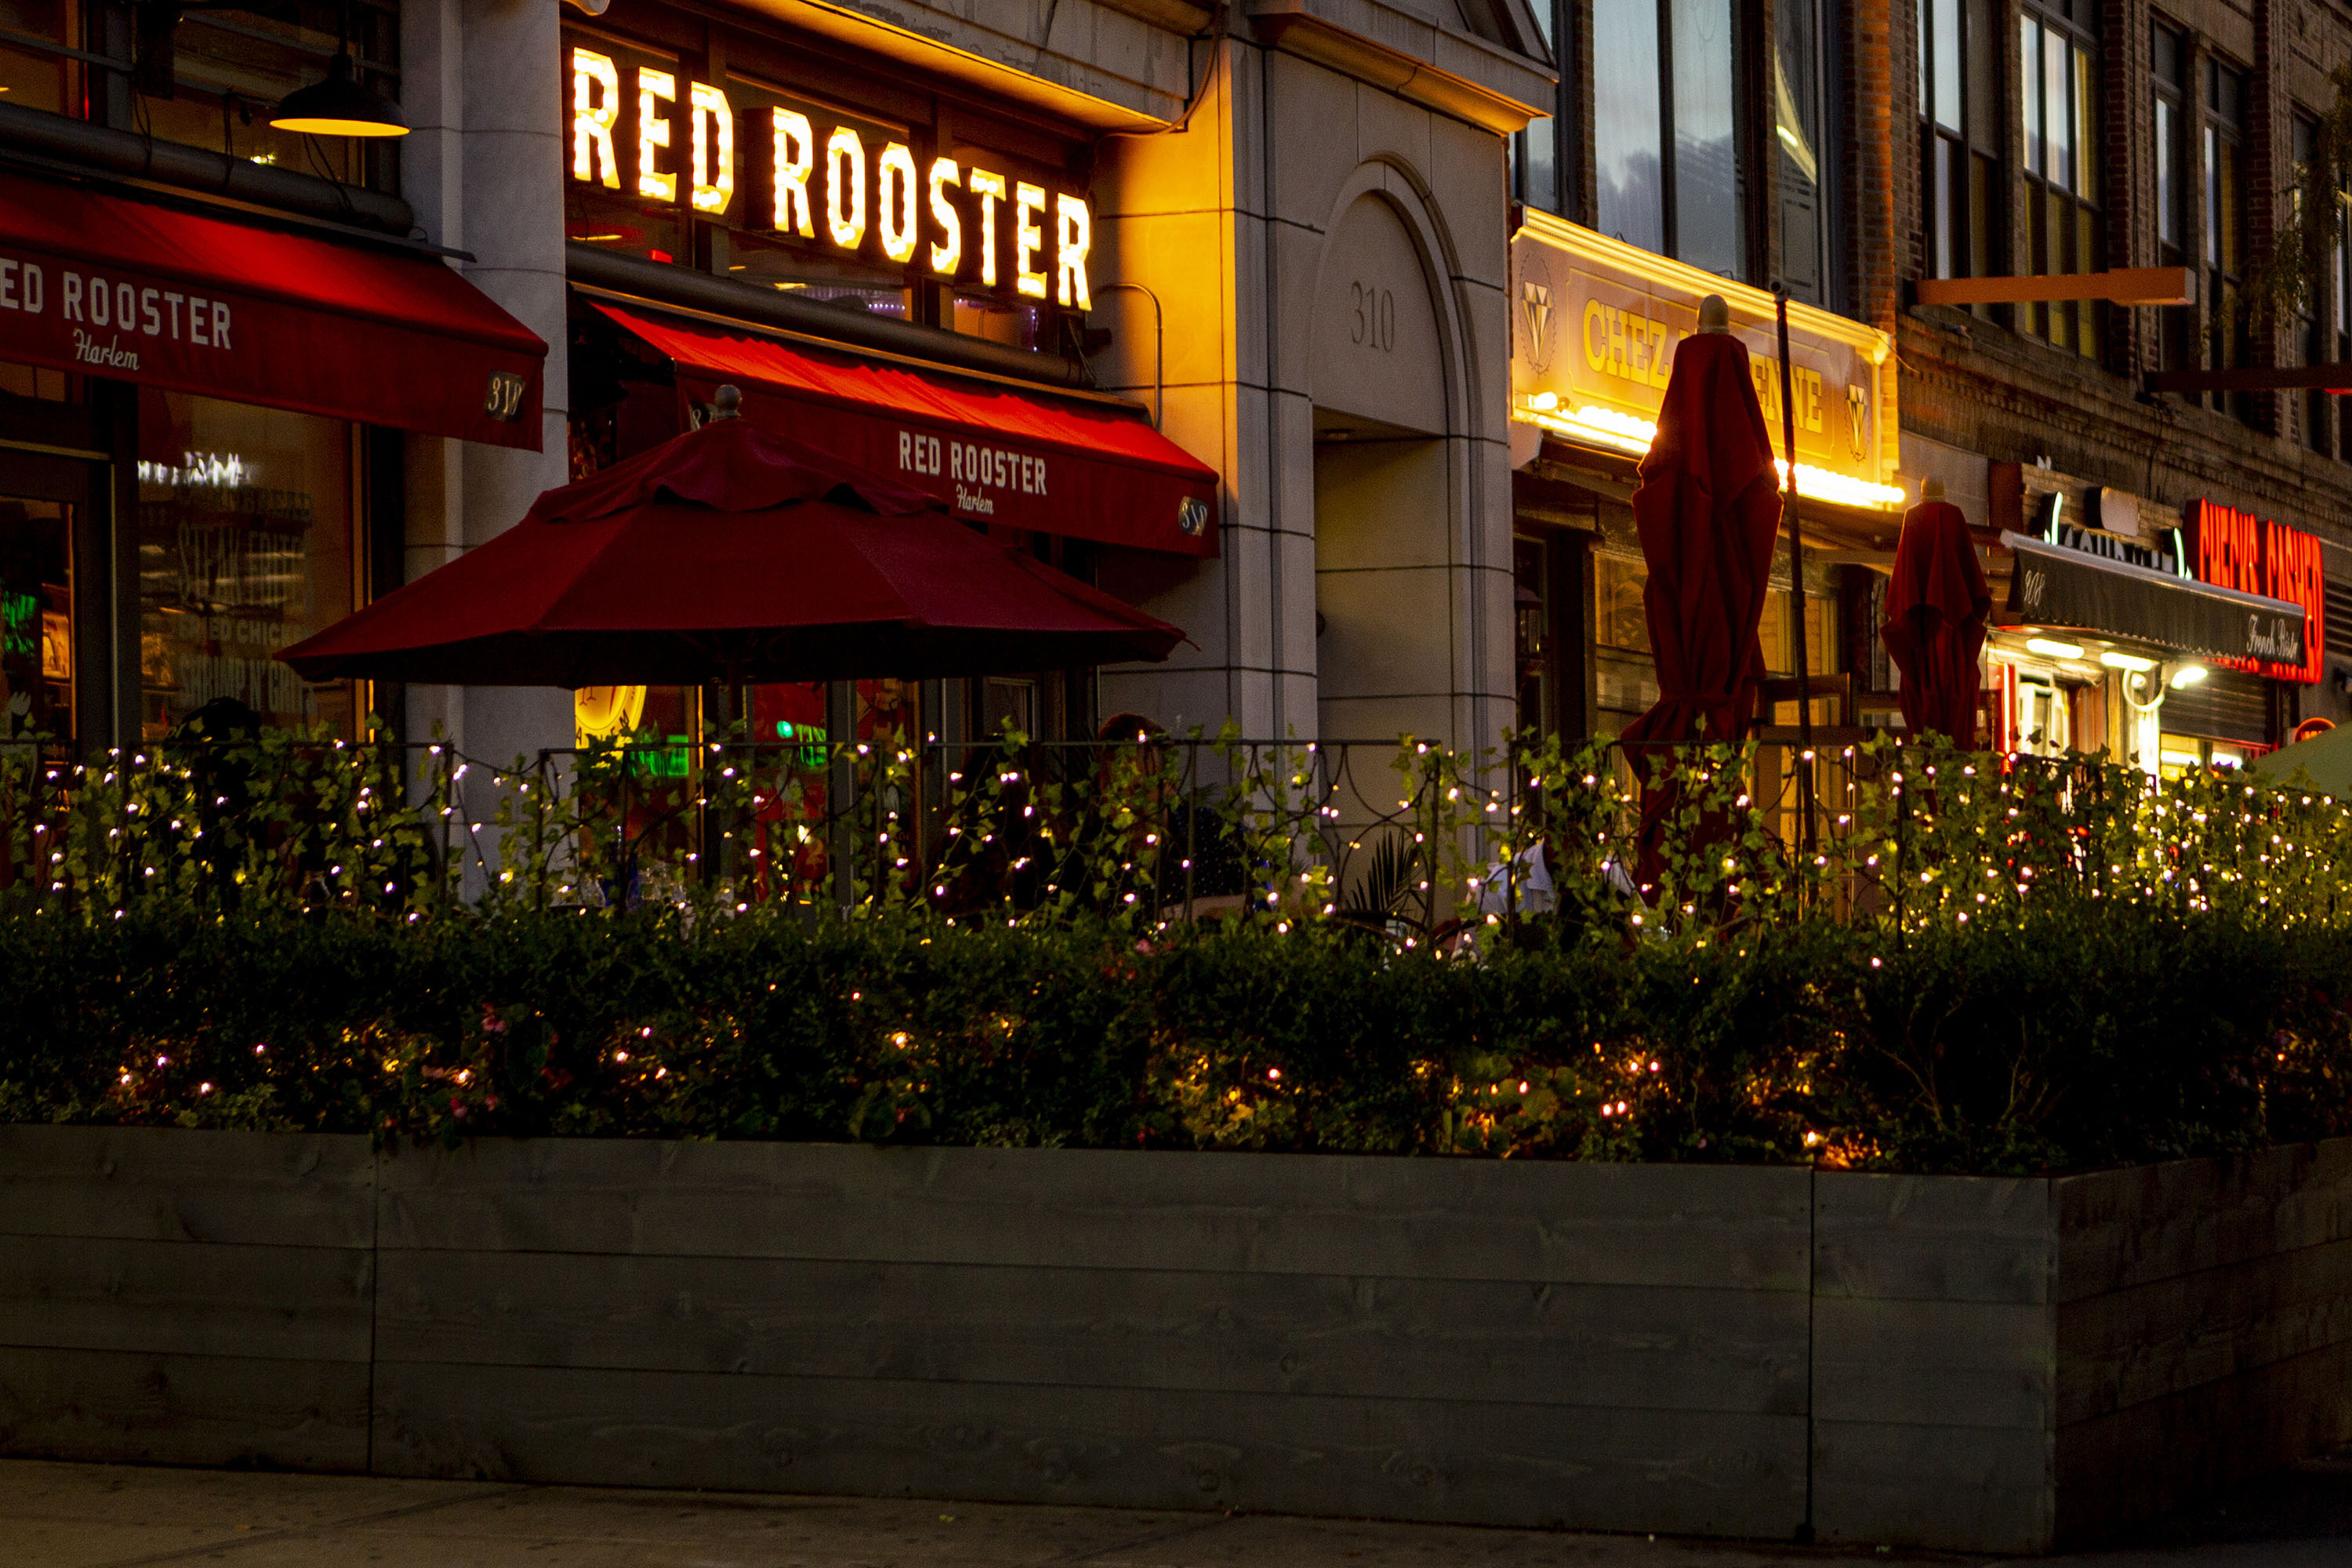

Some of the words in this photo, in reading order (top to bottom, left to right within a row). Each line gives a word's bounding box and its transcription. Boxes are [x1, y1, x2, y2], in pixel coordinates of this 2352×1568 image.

[573, 46, 734, 216] RED
[772, 105, 1093, 312] ROOSTER
[0, 257, 43, 314] ED
[63, 270, 231, 350] ROOSTER
[1350, 281, 1395, 353] 310
[72, 327, 140, 371] Harlem
[1583, 297, 1670, 390] CHEZ
[898, 430, 941, 477] RED
[950, 441, 1047, 496] ROOSTER
[956, 483, 994, 515] Harlem
